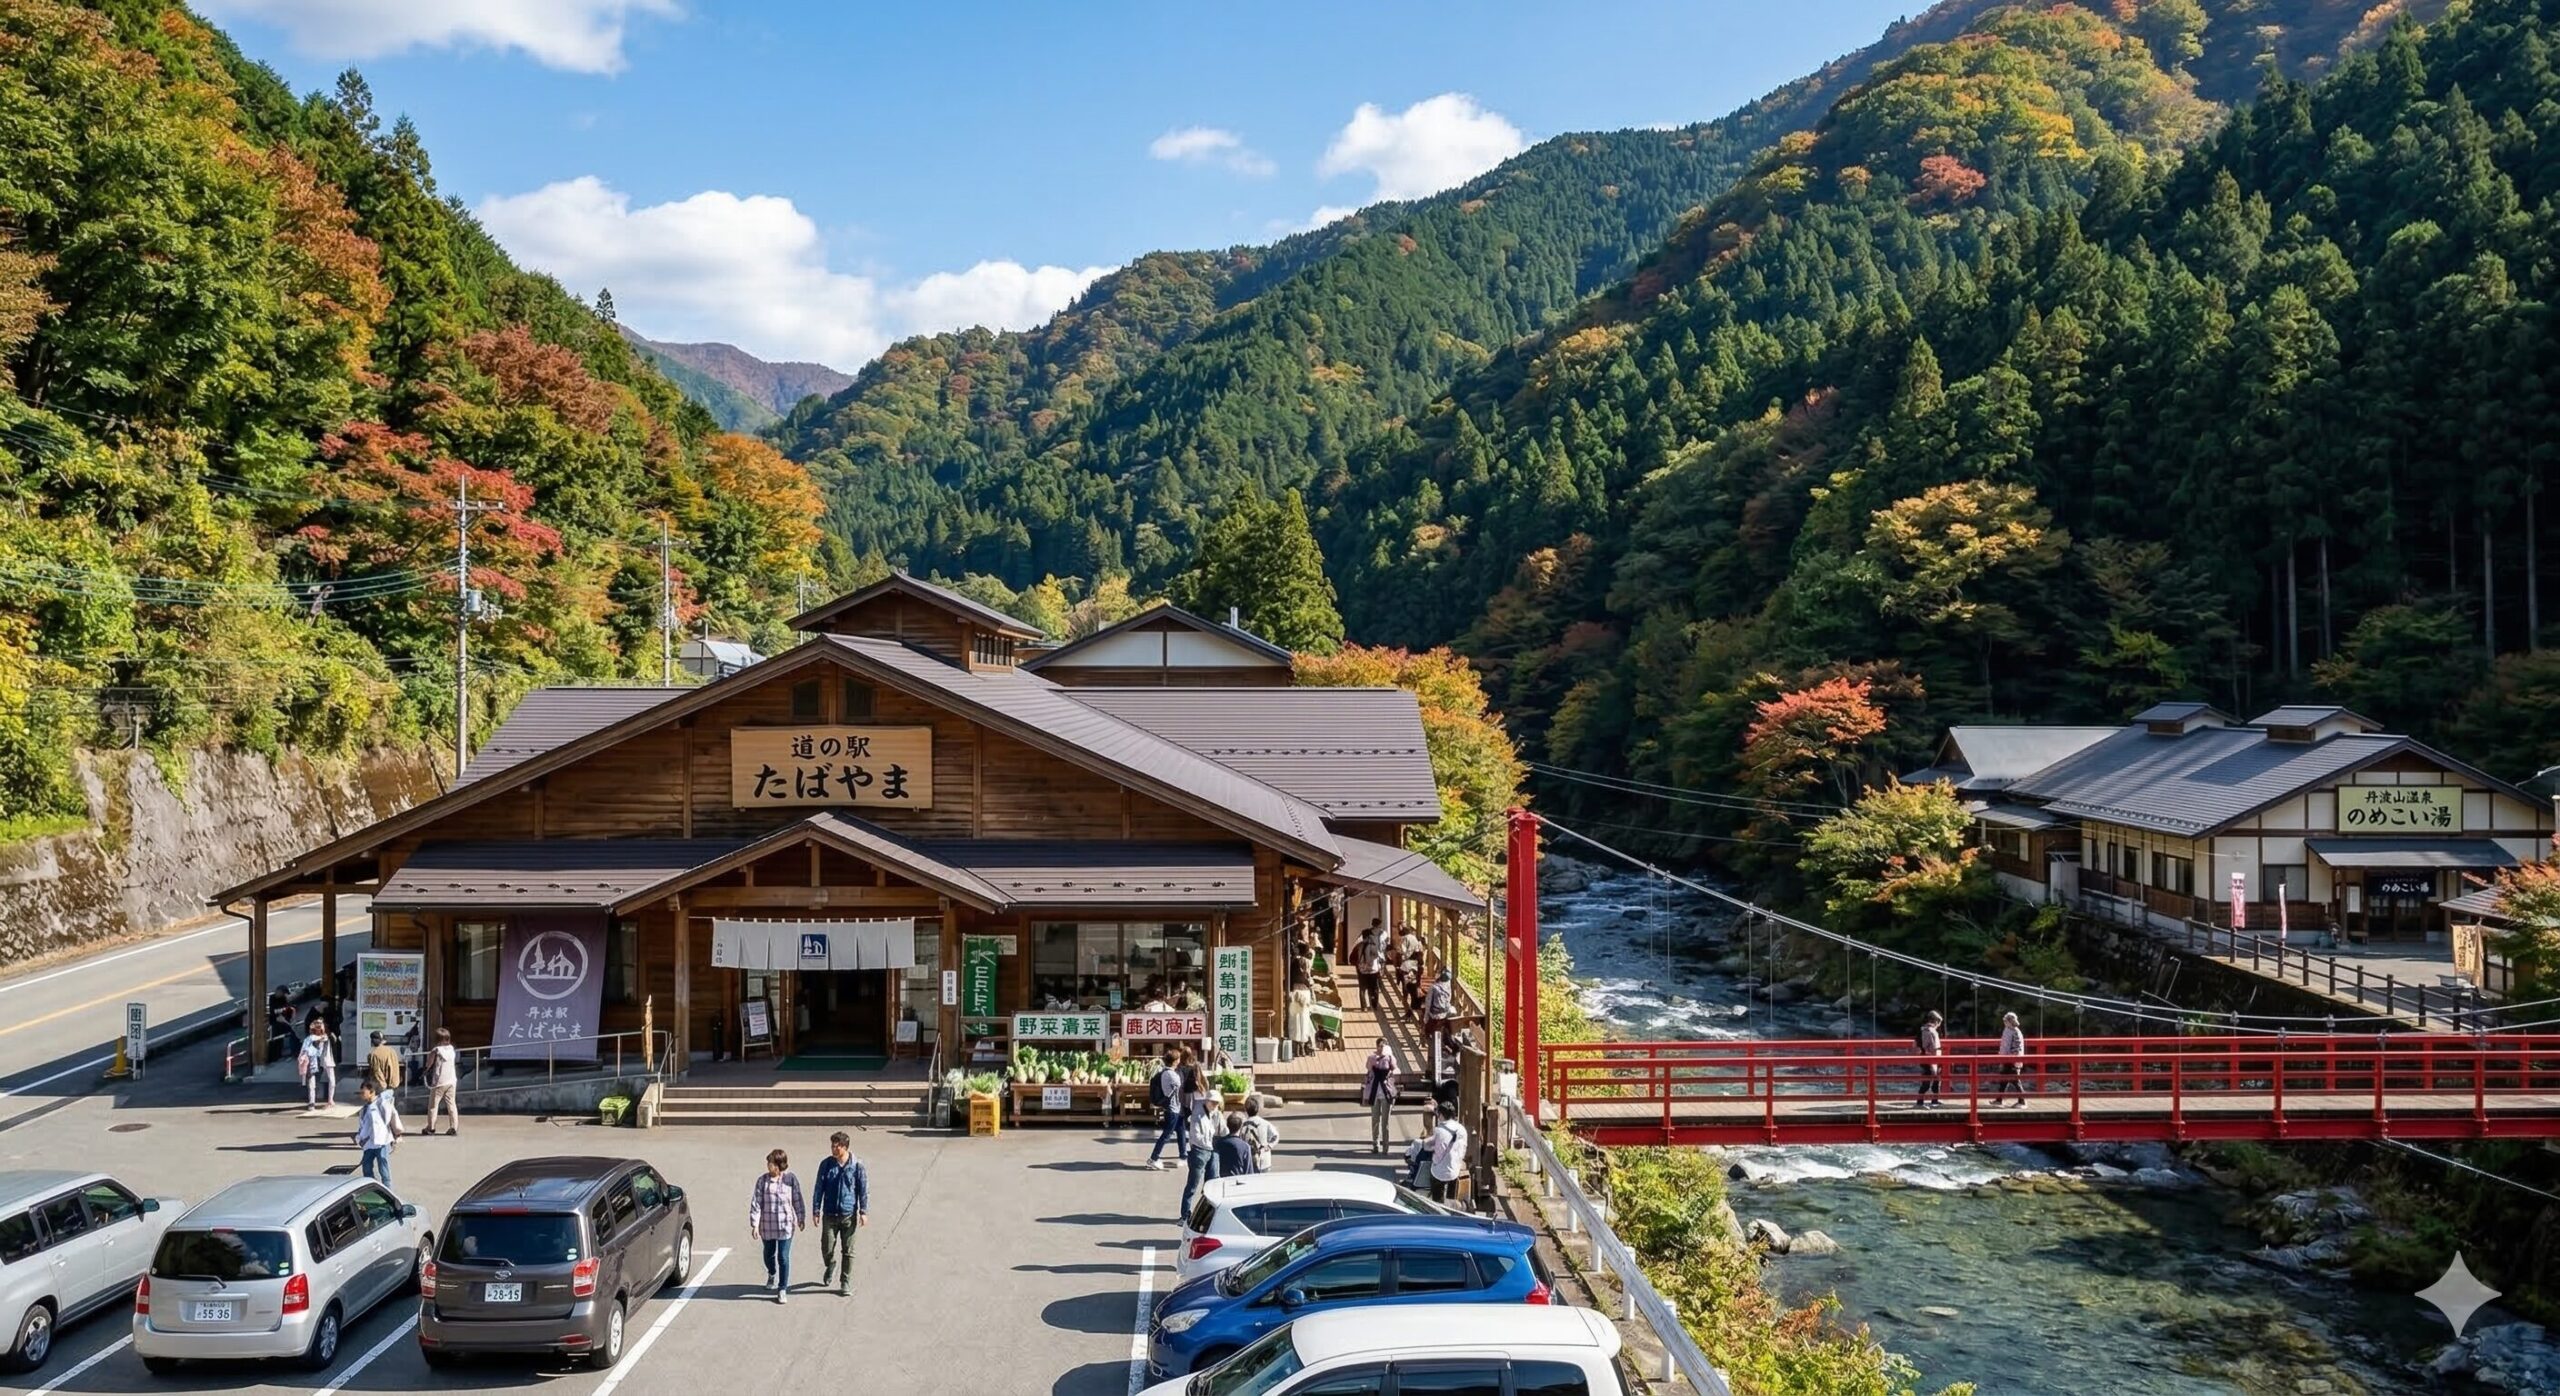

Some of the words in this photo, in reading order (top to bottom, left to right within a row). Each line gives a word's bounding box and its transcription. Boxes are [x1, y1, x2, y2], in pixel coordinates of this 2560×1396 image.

[791, 735, 871, 759] 道の駅
[754, 762, 909, 800] たばやま
[2347, 806, 2452, 828] のめこい湯
[508, 1021, 582, 1039] たばやま
